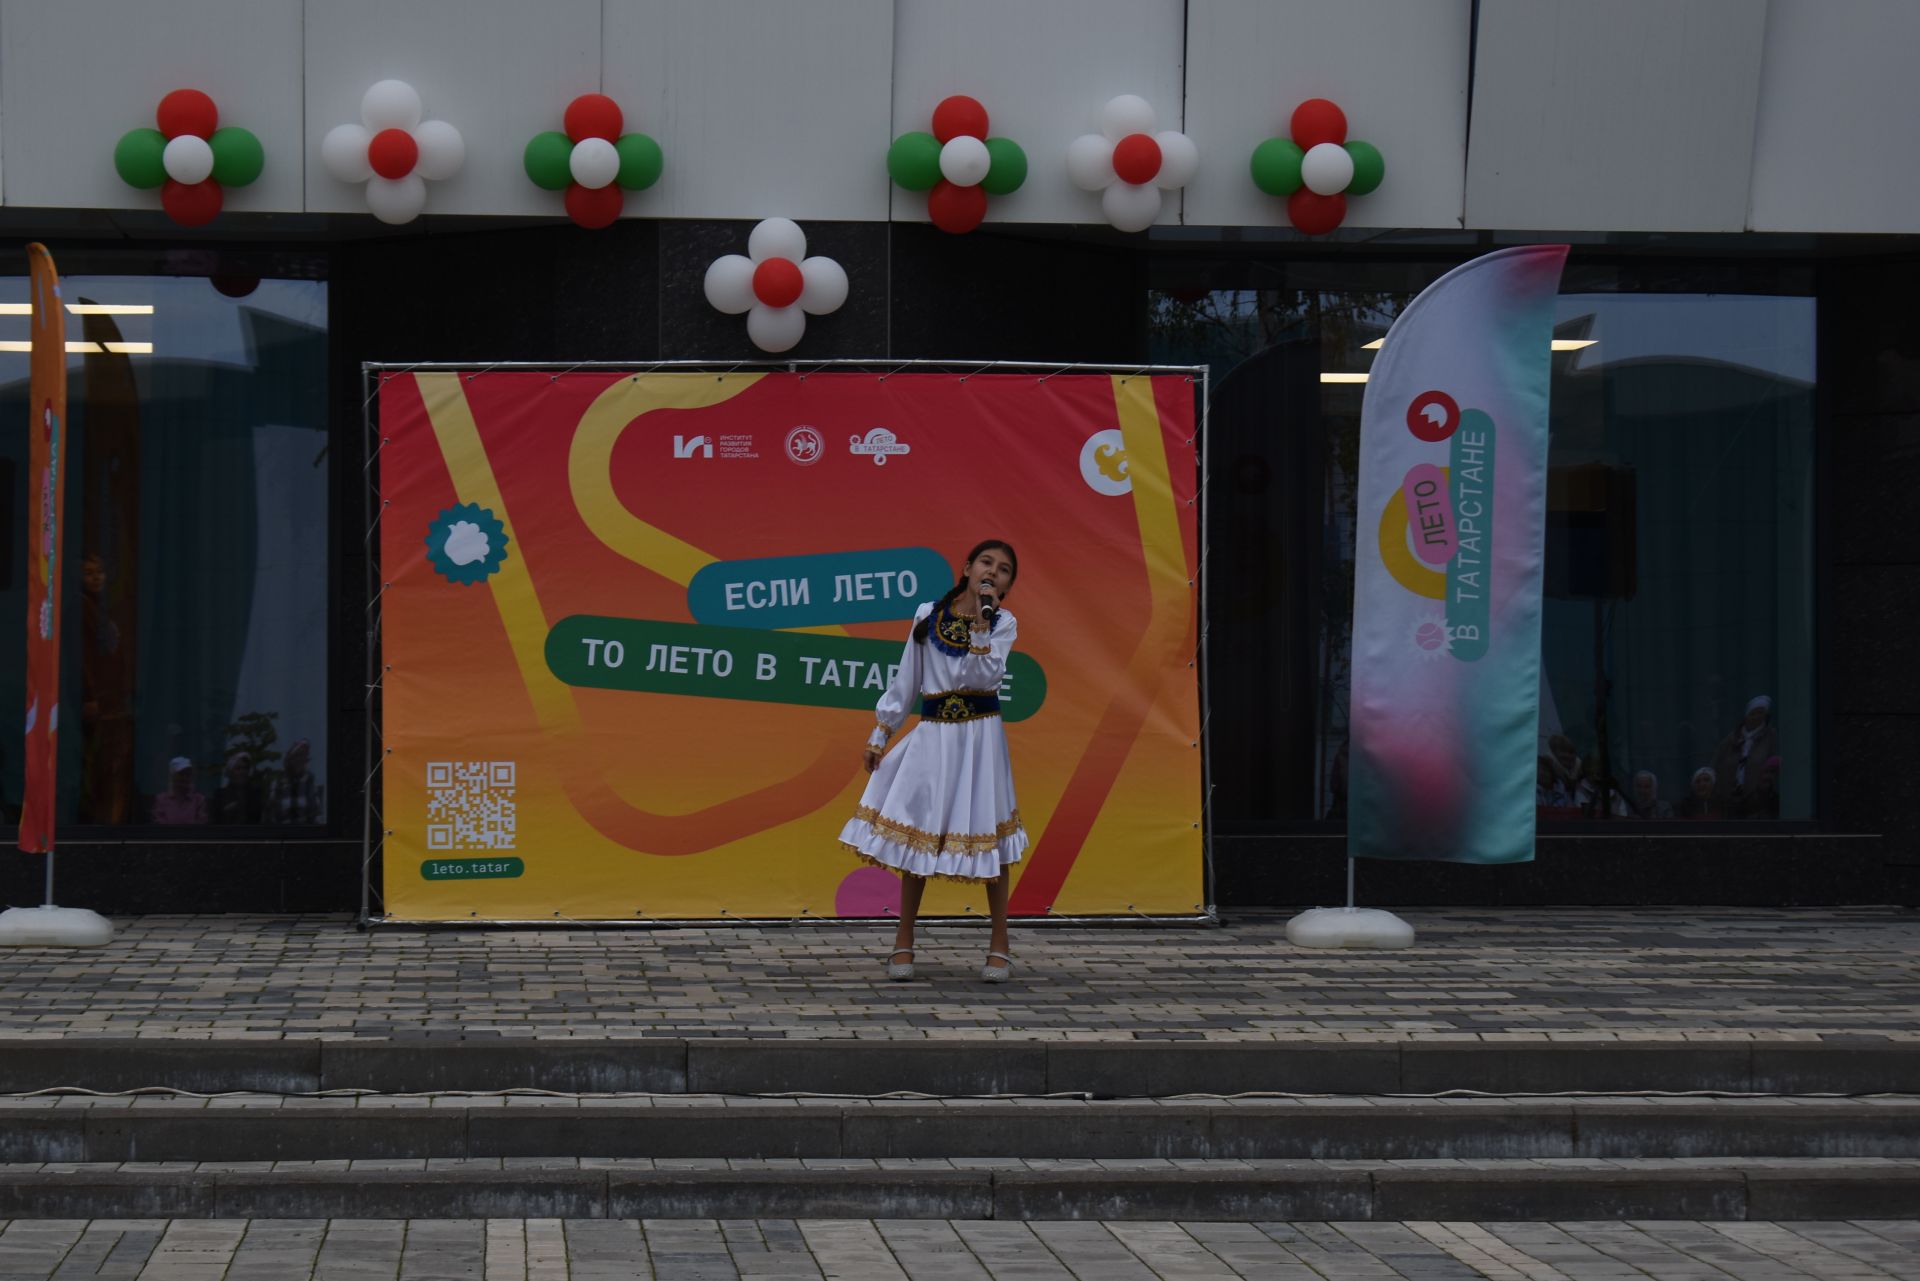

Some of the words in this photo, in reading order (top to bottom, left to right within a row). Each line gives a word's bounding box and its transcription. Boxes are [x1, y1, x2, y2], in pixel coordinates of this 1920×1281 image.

[1414, 480, 1448, 546] ЛЕТО
[1457, 430, 1486, 604] ТАТАРСТАНЕ
[725, 577, 810, 611] ЕСЛИ
[833, 570, 918, 603] ЛЕТО
[1457, 624, 1480, 641] В
[581, 638, 624, 669] ТО
[646, 644, 734, 678] ЛЕТО
[756, 653, 777, 681] В
[799, 656, 1013, 701] ТАТАРЕ
[432, 863, 510, 875] leto.tatar
